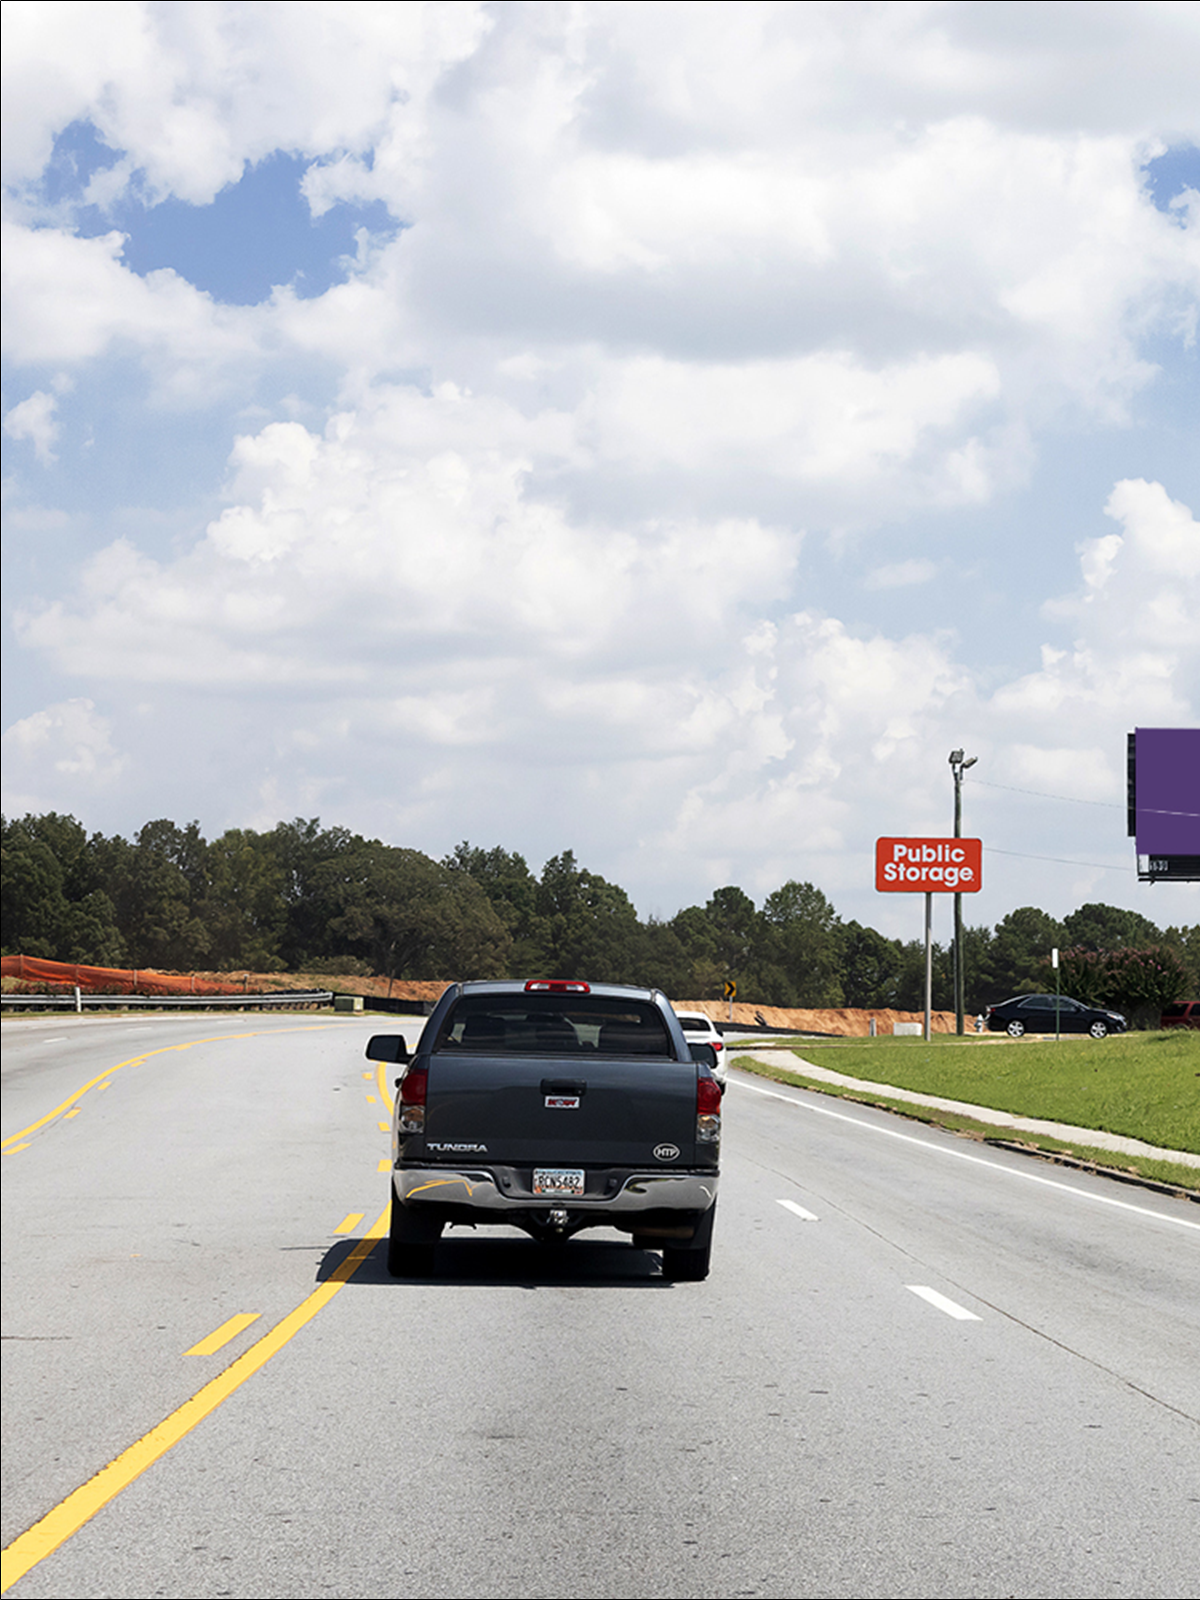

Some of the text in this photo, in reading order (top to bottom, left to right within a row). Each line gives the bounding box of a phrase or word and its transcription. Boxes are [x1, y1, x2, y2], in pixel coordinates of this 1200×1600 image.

[893, 844, 965, 862] Public
[884, 862, 974, 887] Storage
[426, 1143, 489, 1152] TUNDRA
